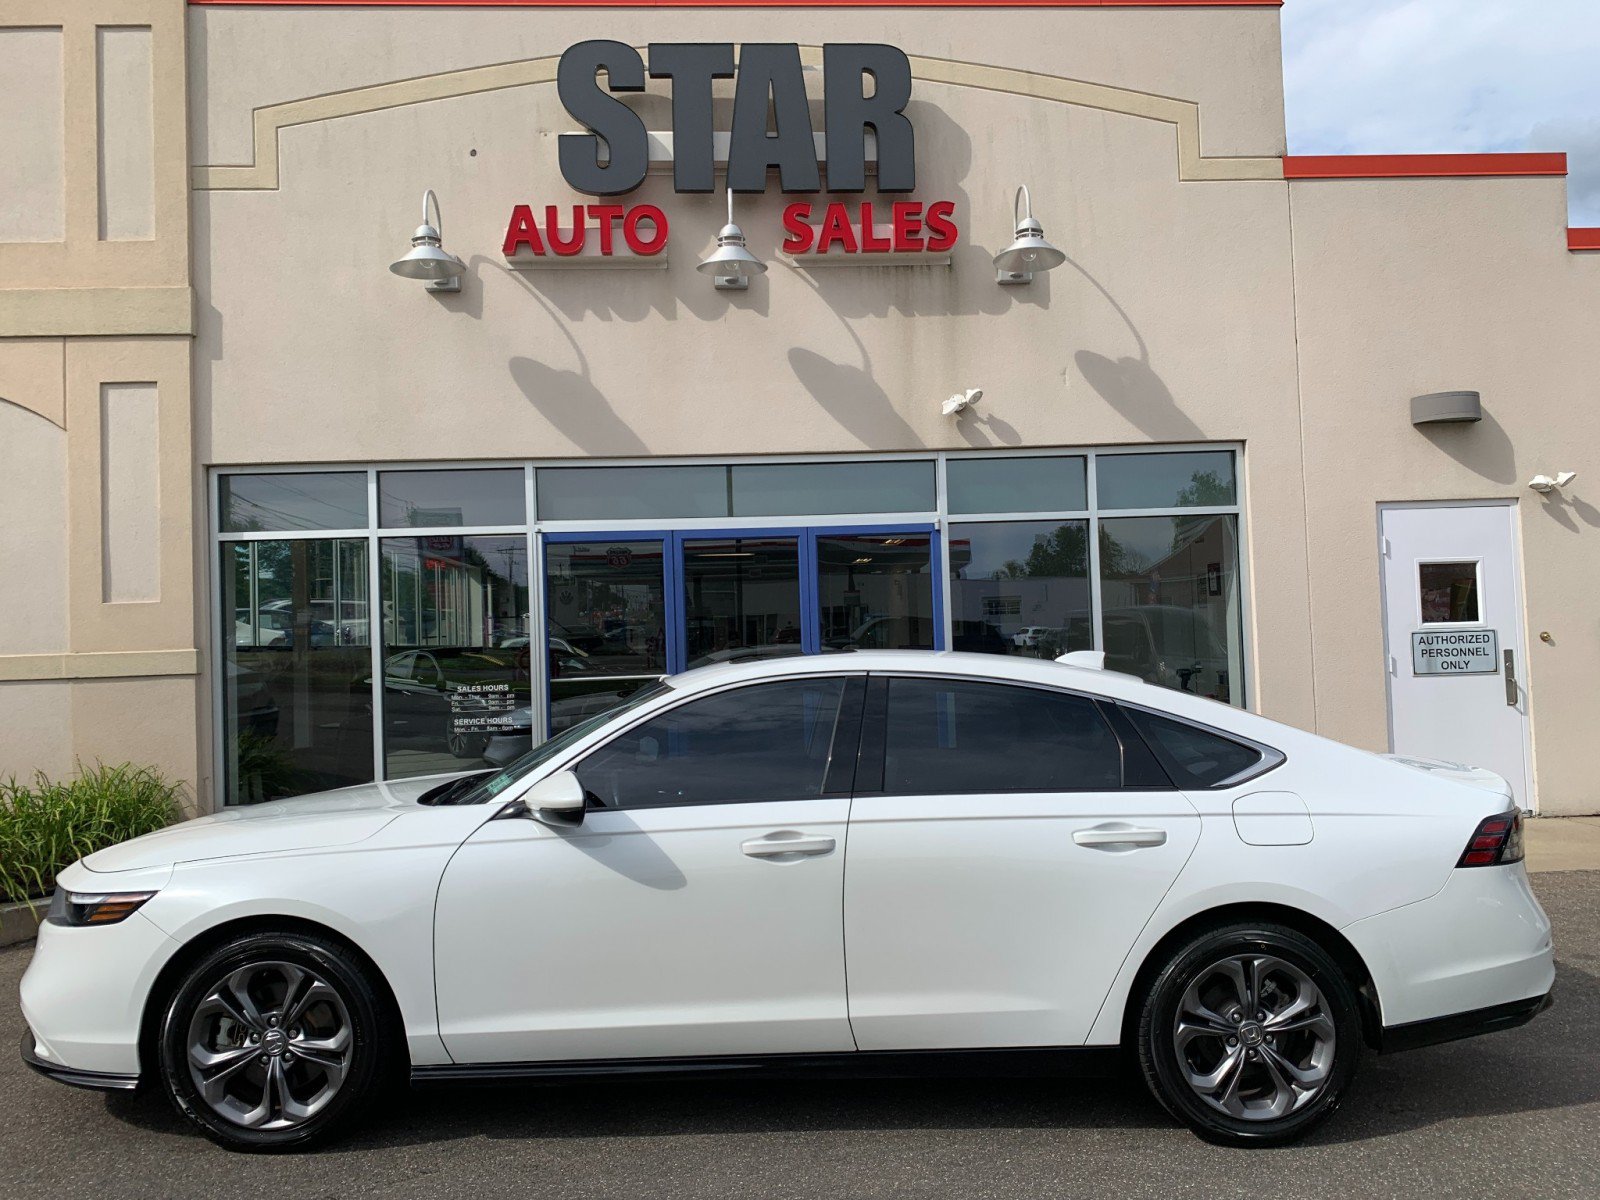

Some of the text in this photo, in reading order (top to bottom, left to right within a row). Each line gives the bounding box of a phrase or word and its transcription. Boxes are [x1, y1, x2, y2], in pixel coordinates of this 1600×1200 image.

[557, 39, 916, 197] STAR
[502, 200, 959, 257] AUTO SALES
[1418, 634, 1490, 645] AUTHORIZED
[1421, 647, 1489, 658] PERSONNEL
[1441, 660, 1470, 670] ONLY
[456, 684, 509, 693] SALES HOURS
[453, 716, 513, 726] SERVICE HOURS
